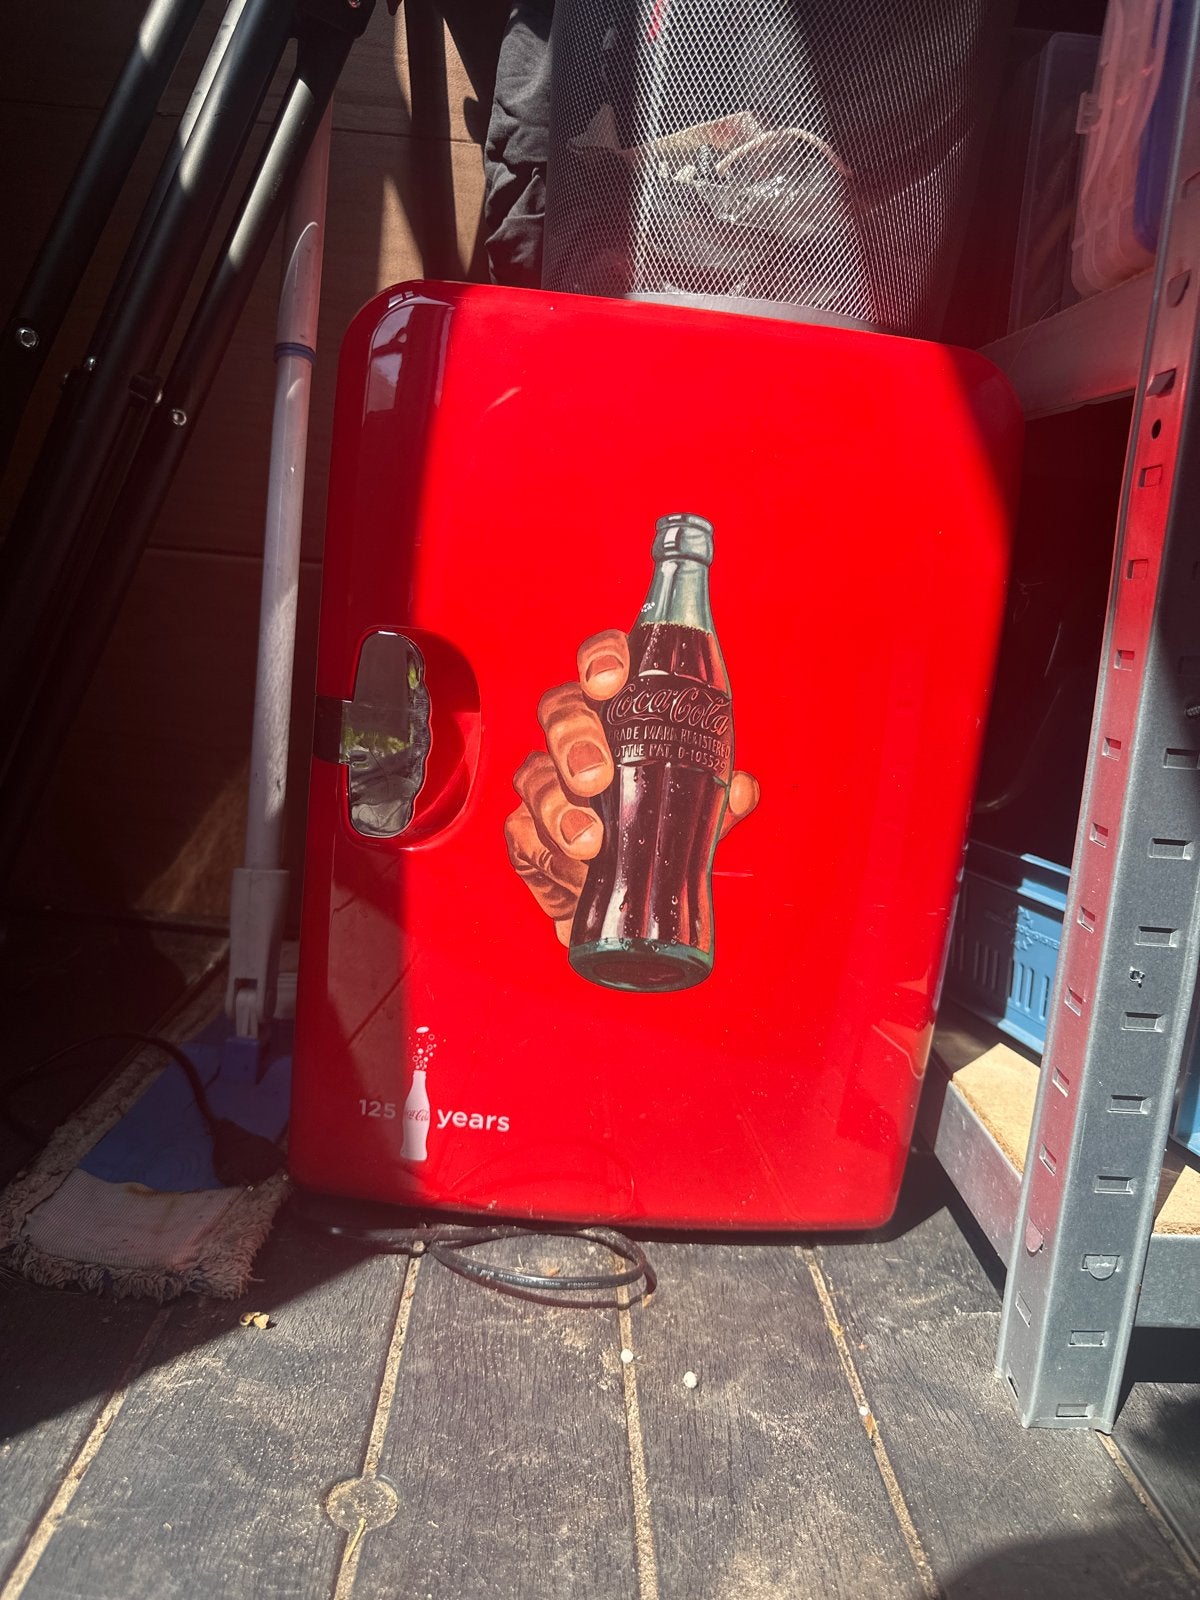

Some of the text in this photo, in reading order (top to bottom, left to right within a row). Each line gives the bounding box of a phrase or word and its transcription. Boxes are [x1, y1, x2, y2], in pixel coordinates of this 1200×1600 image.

[614, 743, 645, 758] OTTLE
[359, 1099, 510, 1132] 125 years
